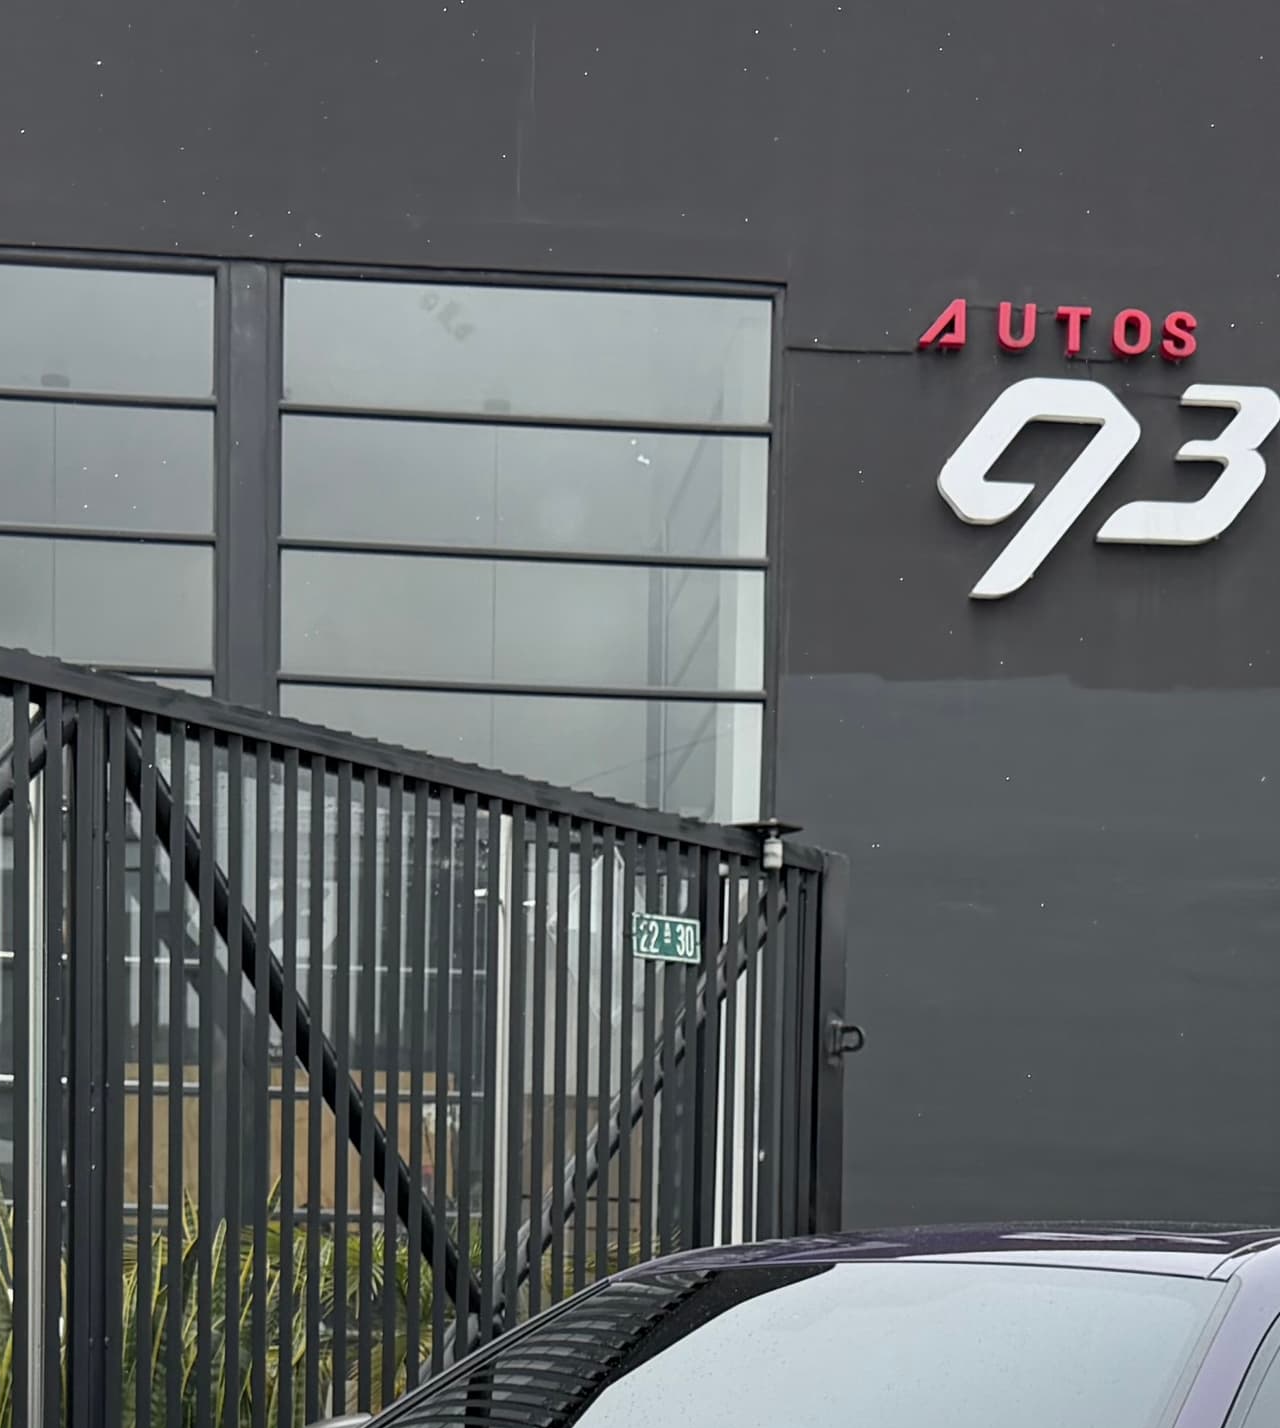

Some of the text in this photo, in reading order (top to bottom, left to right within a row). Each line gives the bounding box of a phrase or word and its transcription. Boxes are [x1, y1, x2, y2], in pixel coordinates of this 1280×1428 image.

[918, 298, 1197, 361] AUTOS
[639, 920, 659, 953] 22
[676, 924, 695, 957] 30
